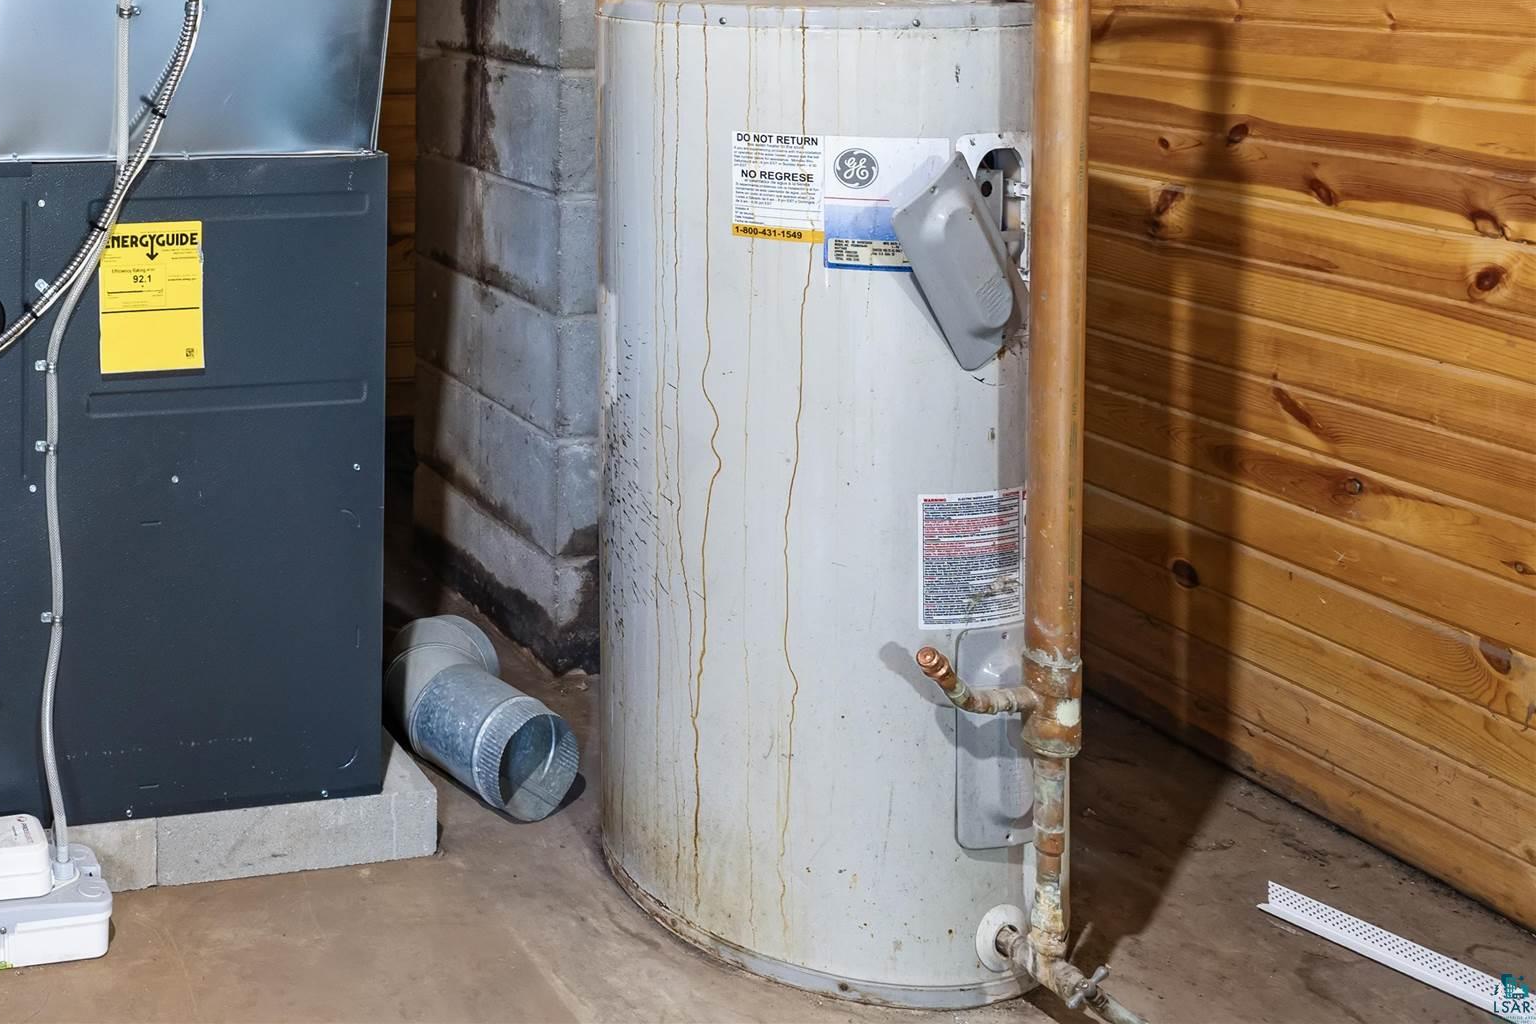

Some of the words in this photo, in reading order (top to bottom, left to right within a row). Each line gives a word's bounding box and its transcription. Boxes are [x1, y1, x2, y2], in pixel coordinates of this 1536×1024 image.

[736, 133, 751, 142] DO
[753, 134, 773, 144] NOT
[776, 135, 818, 146] RETURN
[741, 169, 757, 178] NO
[760, 170, 814, 183] REGRESE
[735, 226, 802, 239] 1-800-431-1549
[133, 274, 152, 284] 92.1
